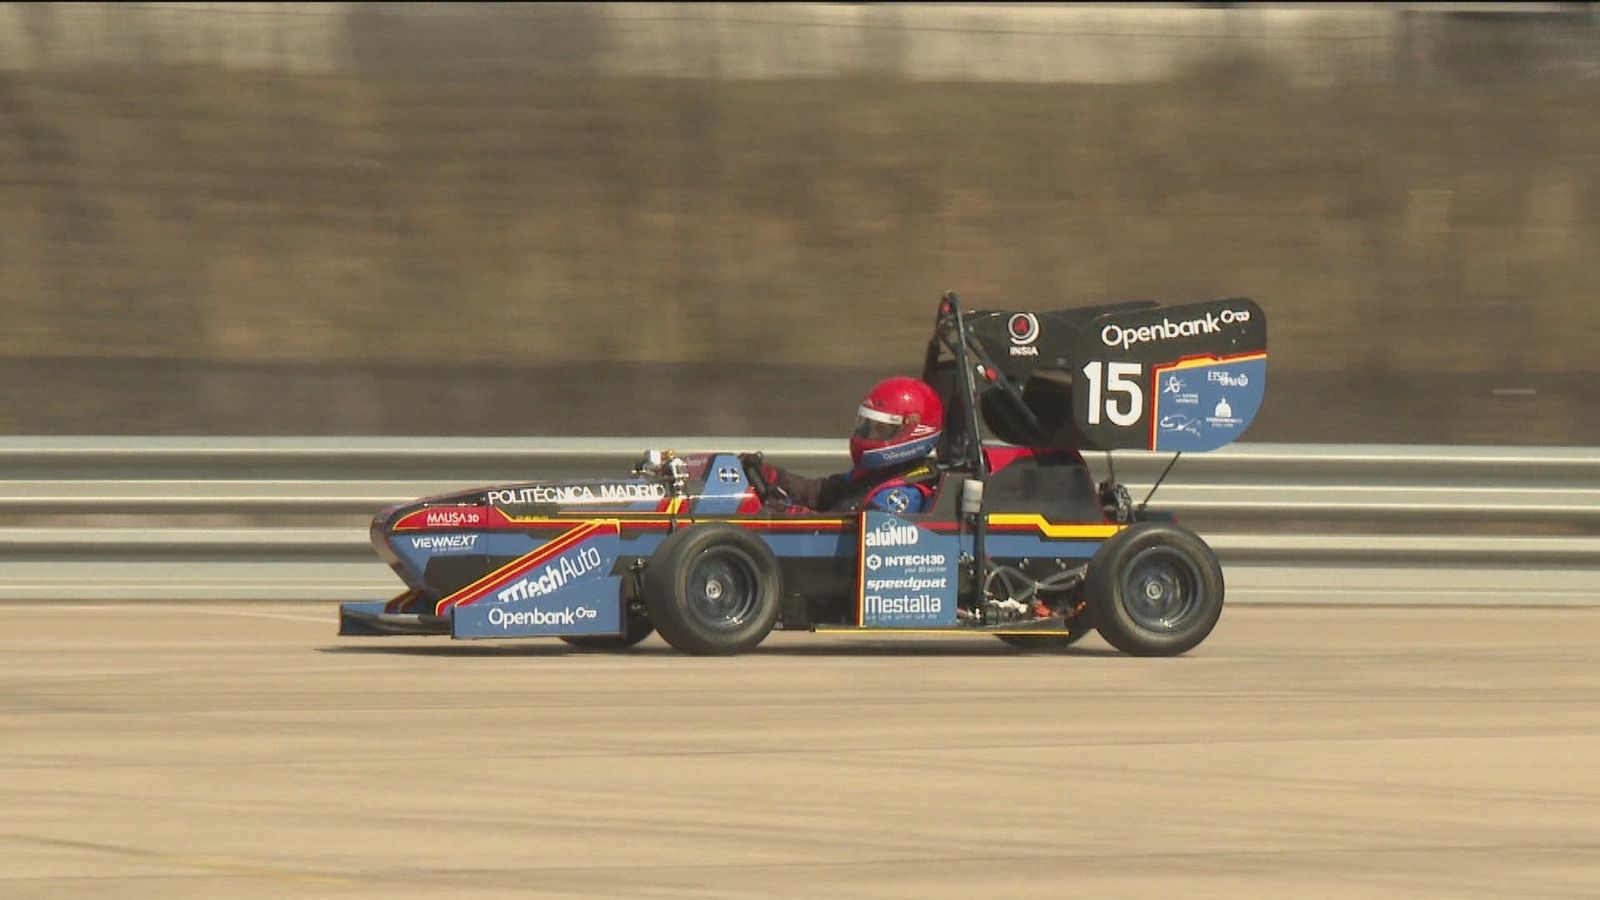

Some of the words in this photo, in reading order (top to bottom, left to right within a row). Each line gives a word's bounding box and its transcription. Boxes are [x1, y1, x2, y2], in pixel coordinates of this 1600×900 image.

[1101, 312, 1221, 350] Openbank
[1009, 346, 1039, 356] INSIA
[1082, 361, 1144, 427] 15
[487, 485, 594, 505] POLITÉCNICA
[600, 484, 667, 501] MADRID
[411, 534, 478, 549] VIEWNEXT
[865, 525, 919, 547] aluNID
[866, 576, 947, 592] speedgoat
[865, 594, 942, 614] Mestalla
[488, 605, 575, 630] Openbank
